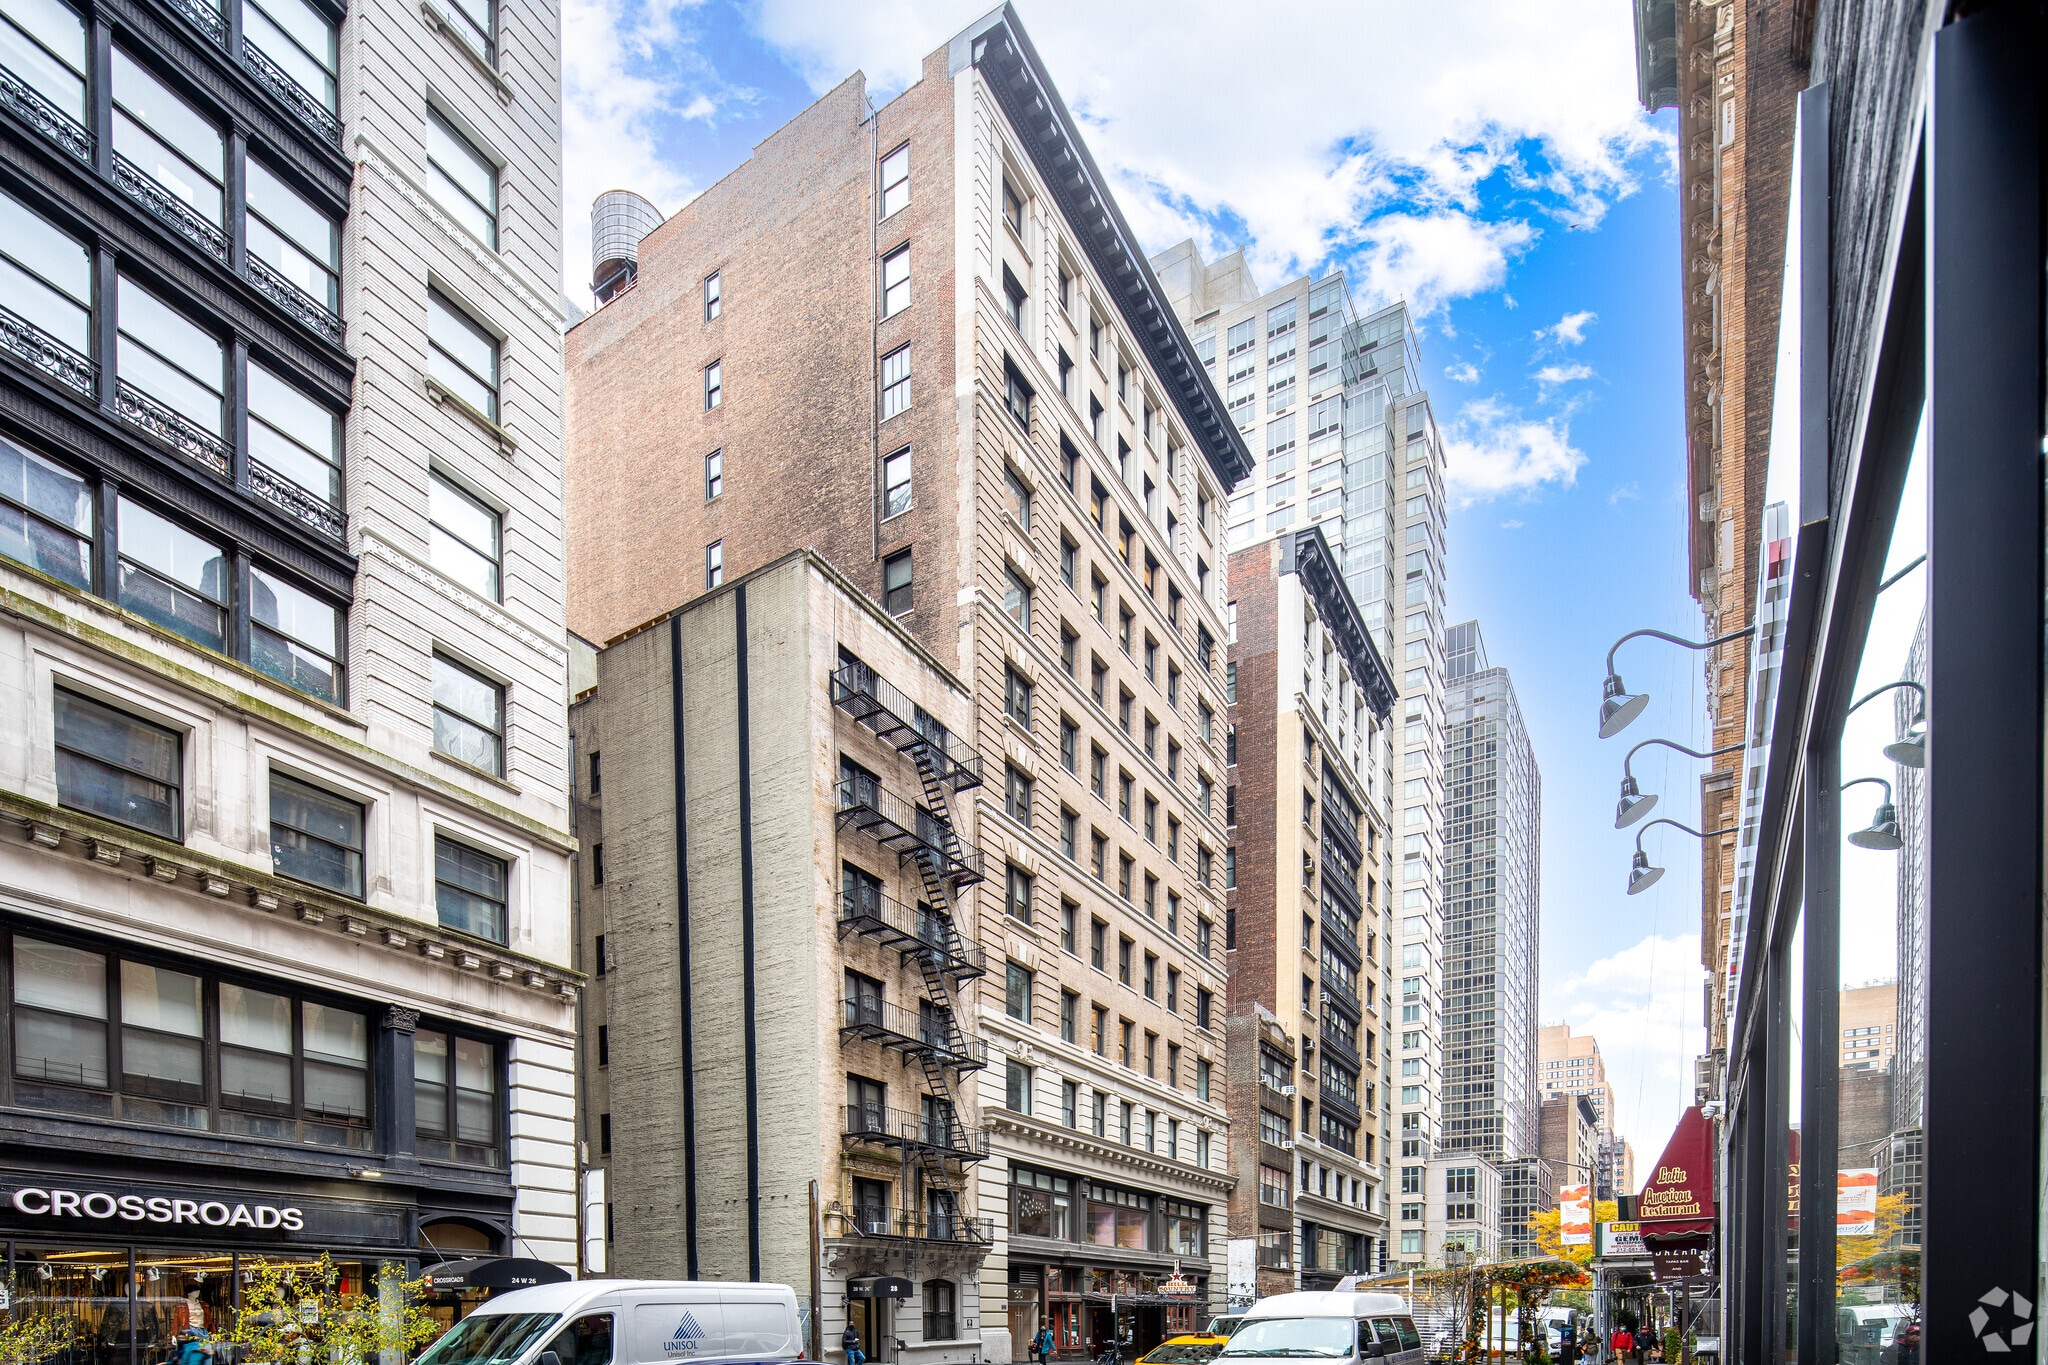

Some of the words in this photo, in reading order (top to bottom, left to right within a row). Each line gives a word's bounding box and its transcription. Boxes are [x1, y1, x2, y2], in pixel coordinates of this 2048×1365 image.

[1656, 1166, 1687, 1184] Latin
[1643, 1187, 1692, 1205] American
[12, 1188, 304, 1231] CROSSROADS
[1640, 1202, 1700, 1217] Restaurant
[433, 1276, 464, 1284] CROSSROADS
[663, 1340, 699, 1351] UNISOL
